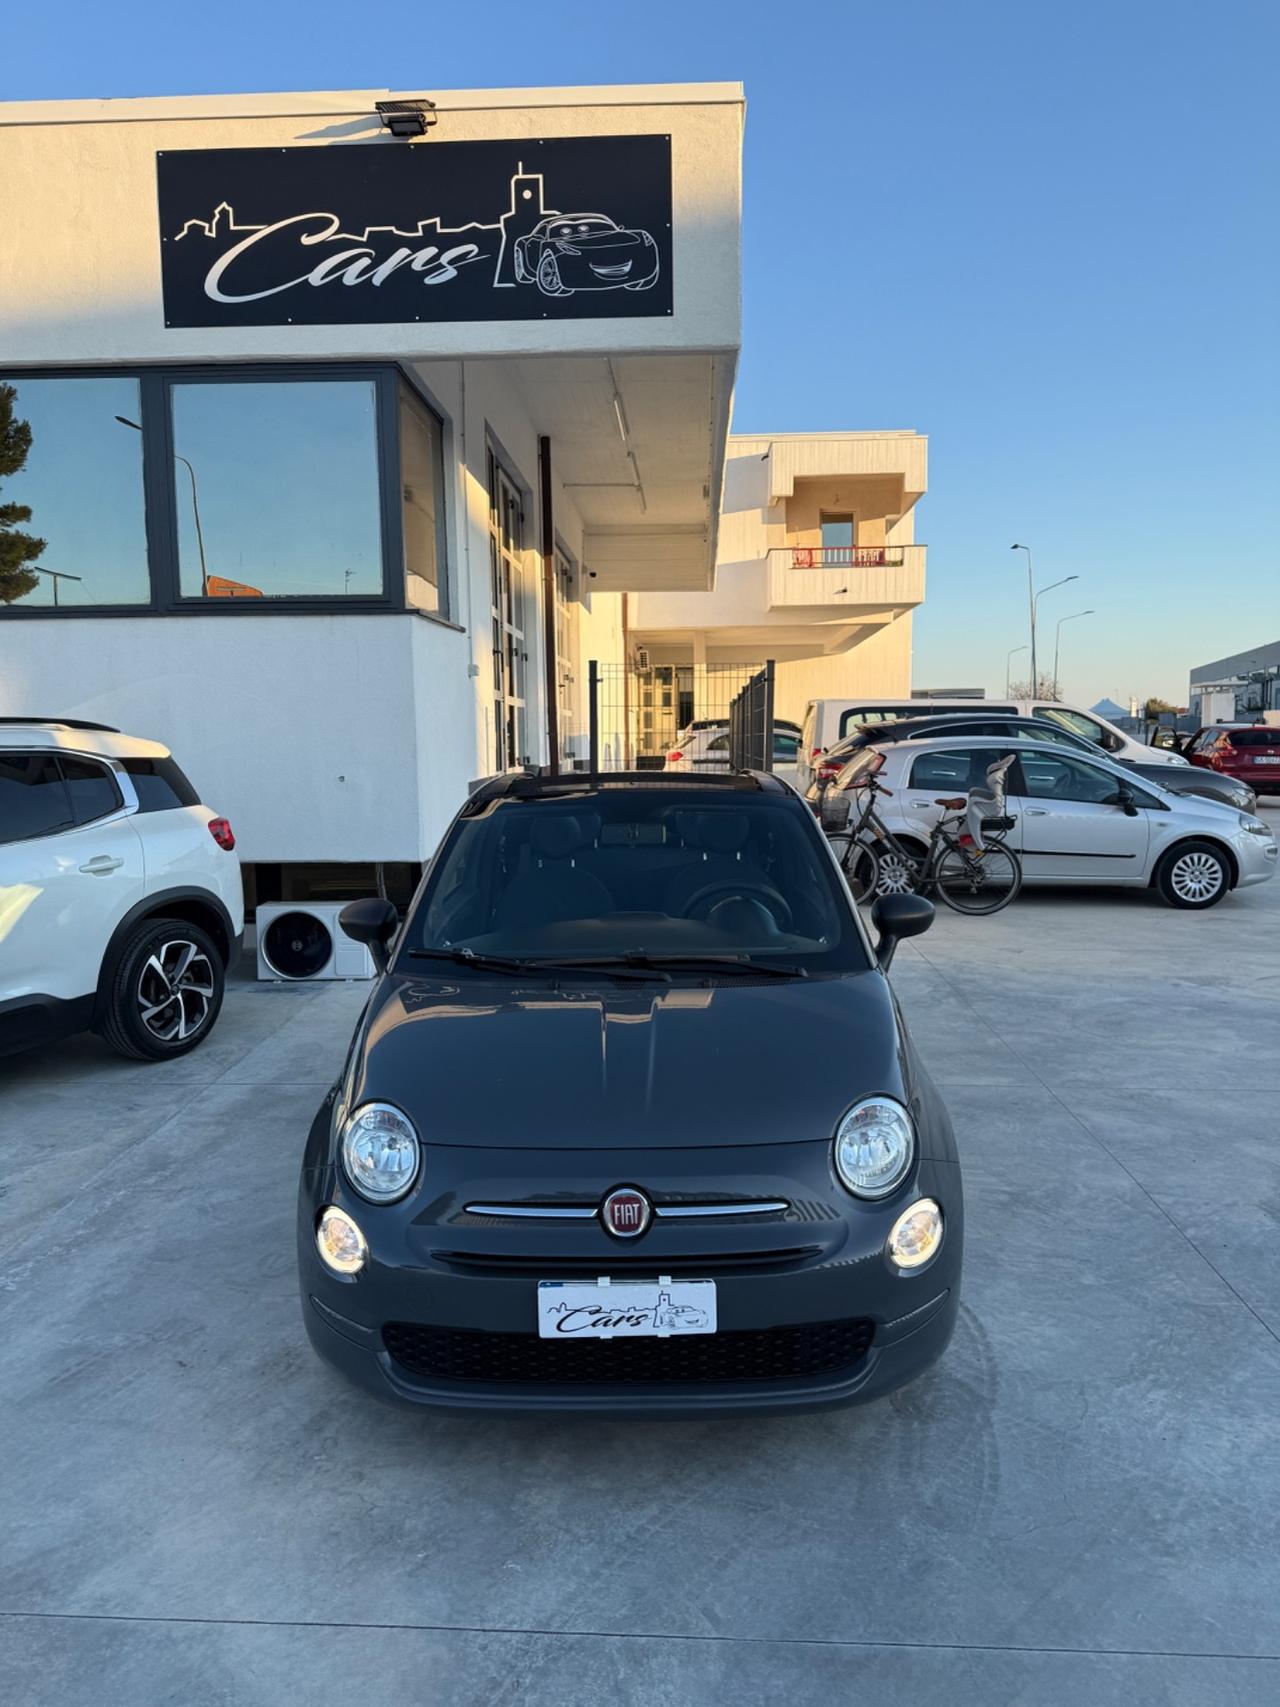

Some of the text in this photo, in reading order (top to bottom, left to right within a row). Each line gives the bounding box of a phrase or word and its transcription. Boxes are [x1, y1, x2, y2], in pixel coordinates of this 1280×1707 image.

[203, 212, 492, 304] Cars
[613, 1203, 641, 1225] FIAT
[556, 1304, 651, 1333] Cars
